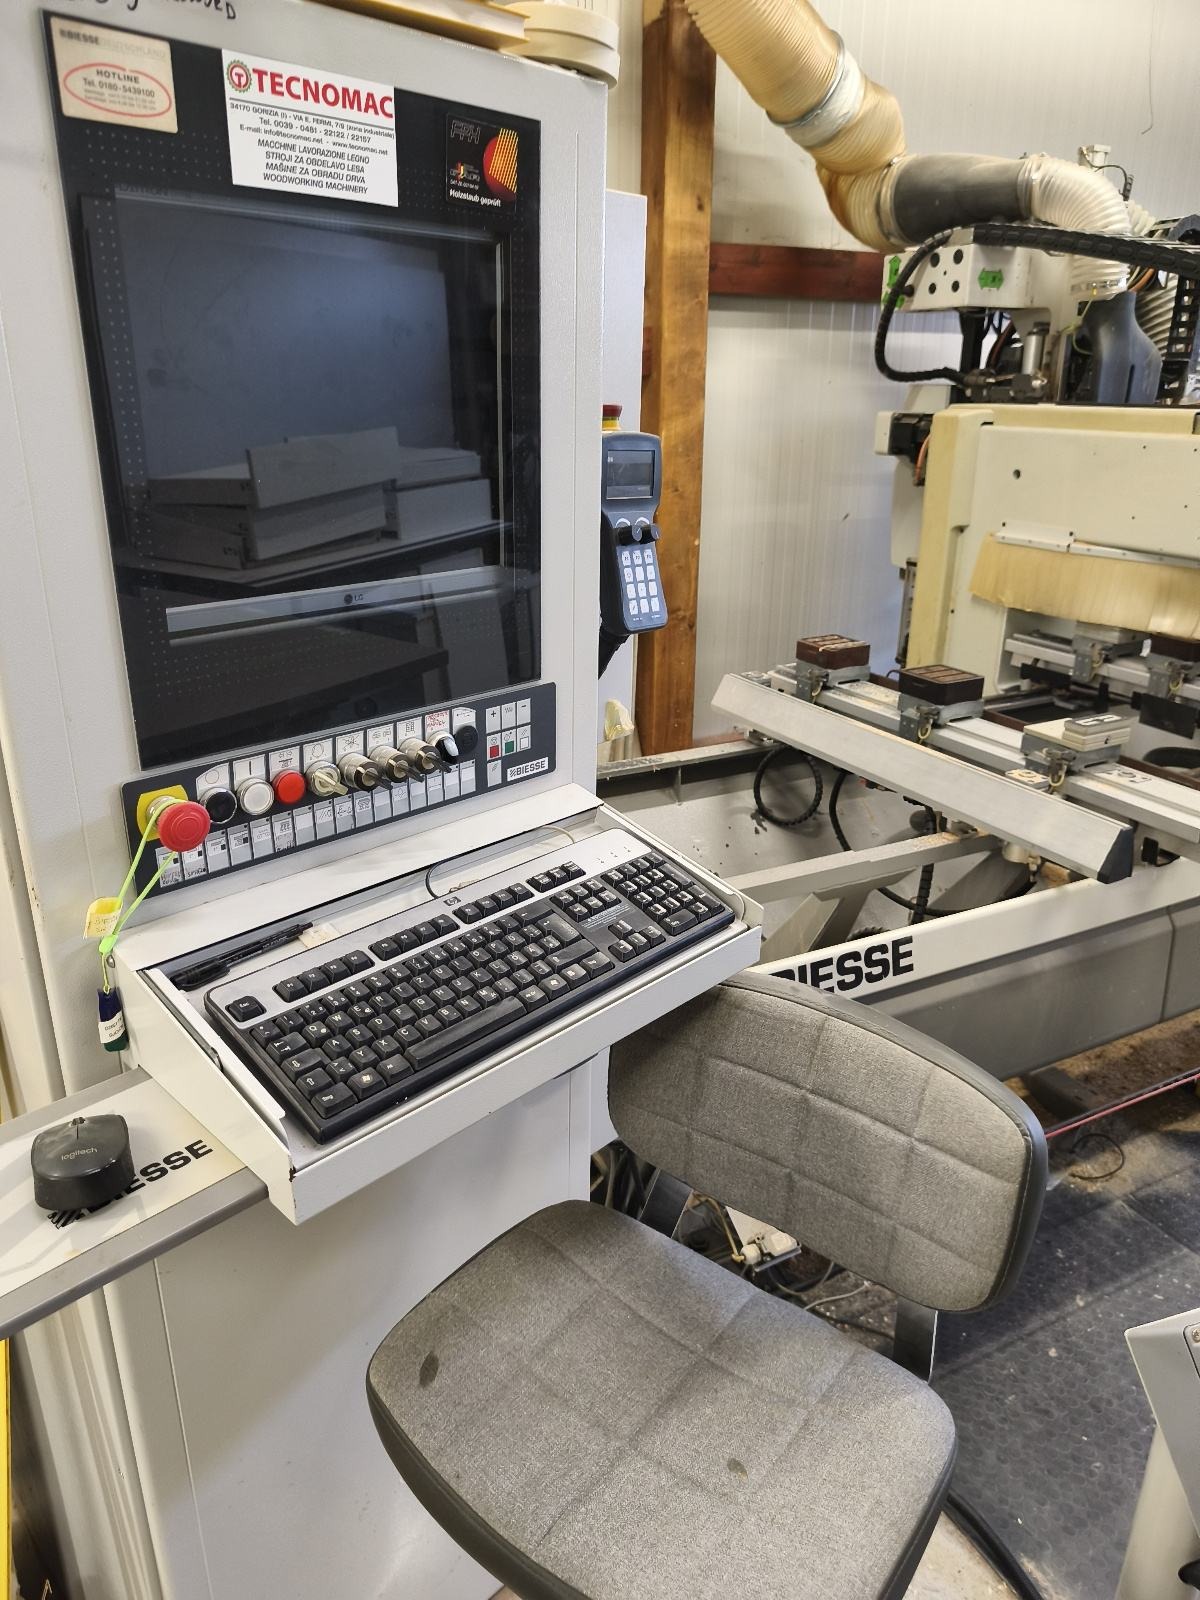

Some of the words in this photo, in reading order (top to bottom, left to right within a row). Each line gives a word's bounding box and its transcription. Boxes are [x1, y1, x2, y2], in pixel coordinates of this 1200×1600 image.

[83, 77, 96, 87] Tel.
[98, 80, 118, 92] 0180
[95, 68, 140, 84] HOTLINE
[252, 67, 394, 119] TECNOMAC
[230, 102, 251, 112] 34170
[252, 106, 279, 117] GORIZIA
[293, 113, 303, 121] VIA
[240, 123, 262, 134] E-mail:
[259, 117, 272, 126] Tel.
[274, 120, 293, 130] 0039
[300, 124, 317, 134] 0481
[324, 128, 345, 139] 22122
[257, 138, 297, 153] MACCHINE
[299, 144, 345, 160] LAVORAZIONE
[347, 153, 370, 165] LEGNO
[265, 150, 293, 163] STROJI
[294, 156, 304, 165] ZA
[306, 156, 345, 171] OBDELAVO
[347, 162, 365, 174] LESA
[263, 172, 323, 189] WOODWORKING
[325, 181, 368, 194] MACHINERY
[265, 161, 297, 175] MAŠINE
[300, 166, 309, 176] ZA
[311, 169, 344, 181] OBRADU
[345, 174, 366, 184] DRVA
[516, 760, 546, 776] BIESSE
[769, 936, 914, 993] IESSE
[61, 1147, 98, 1161] logitech
